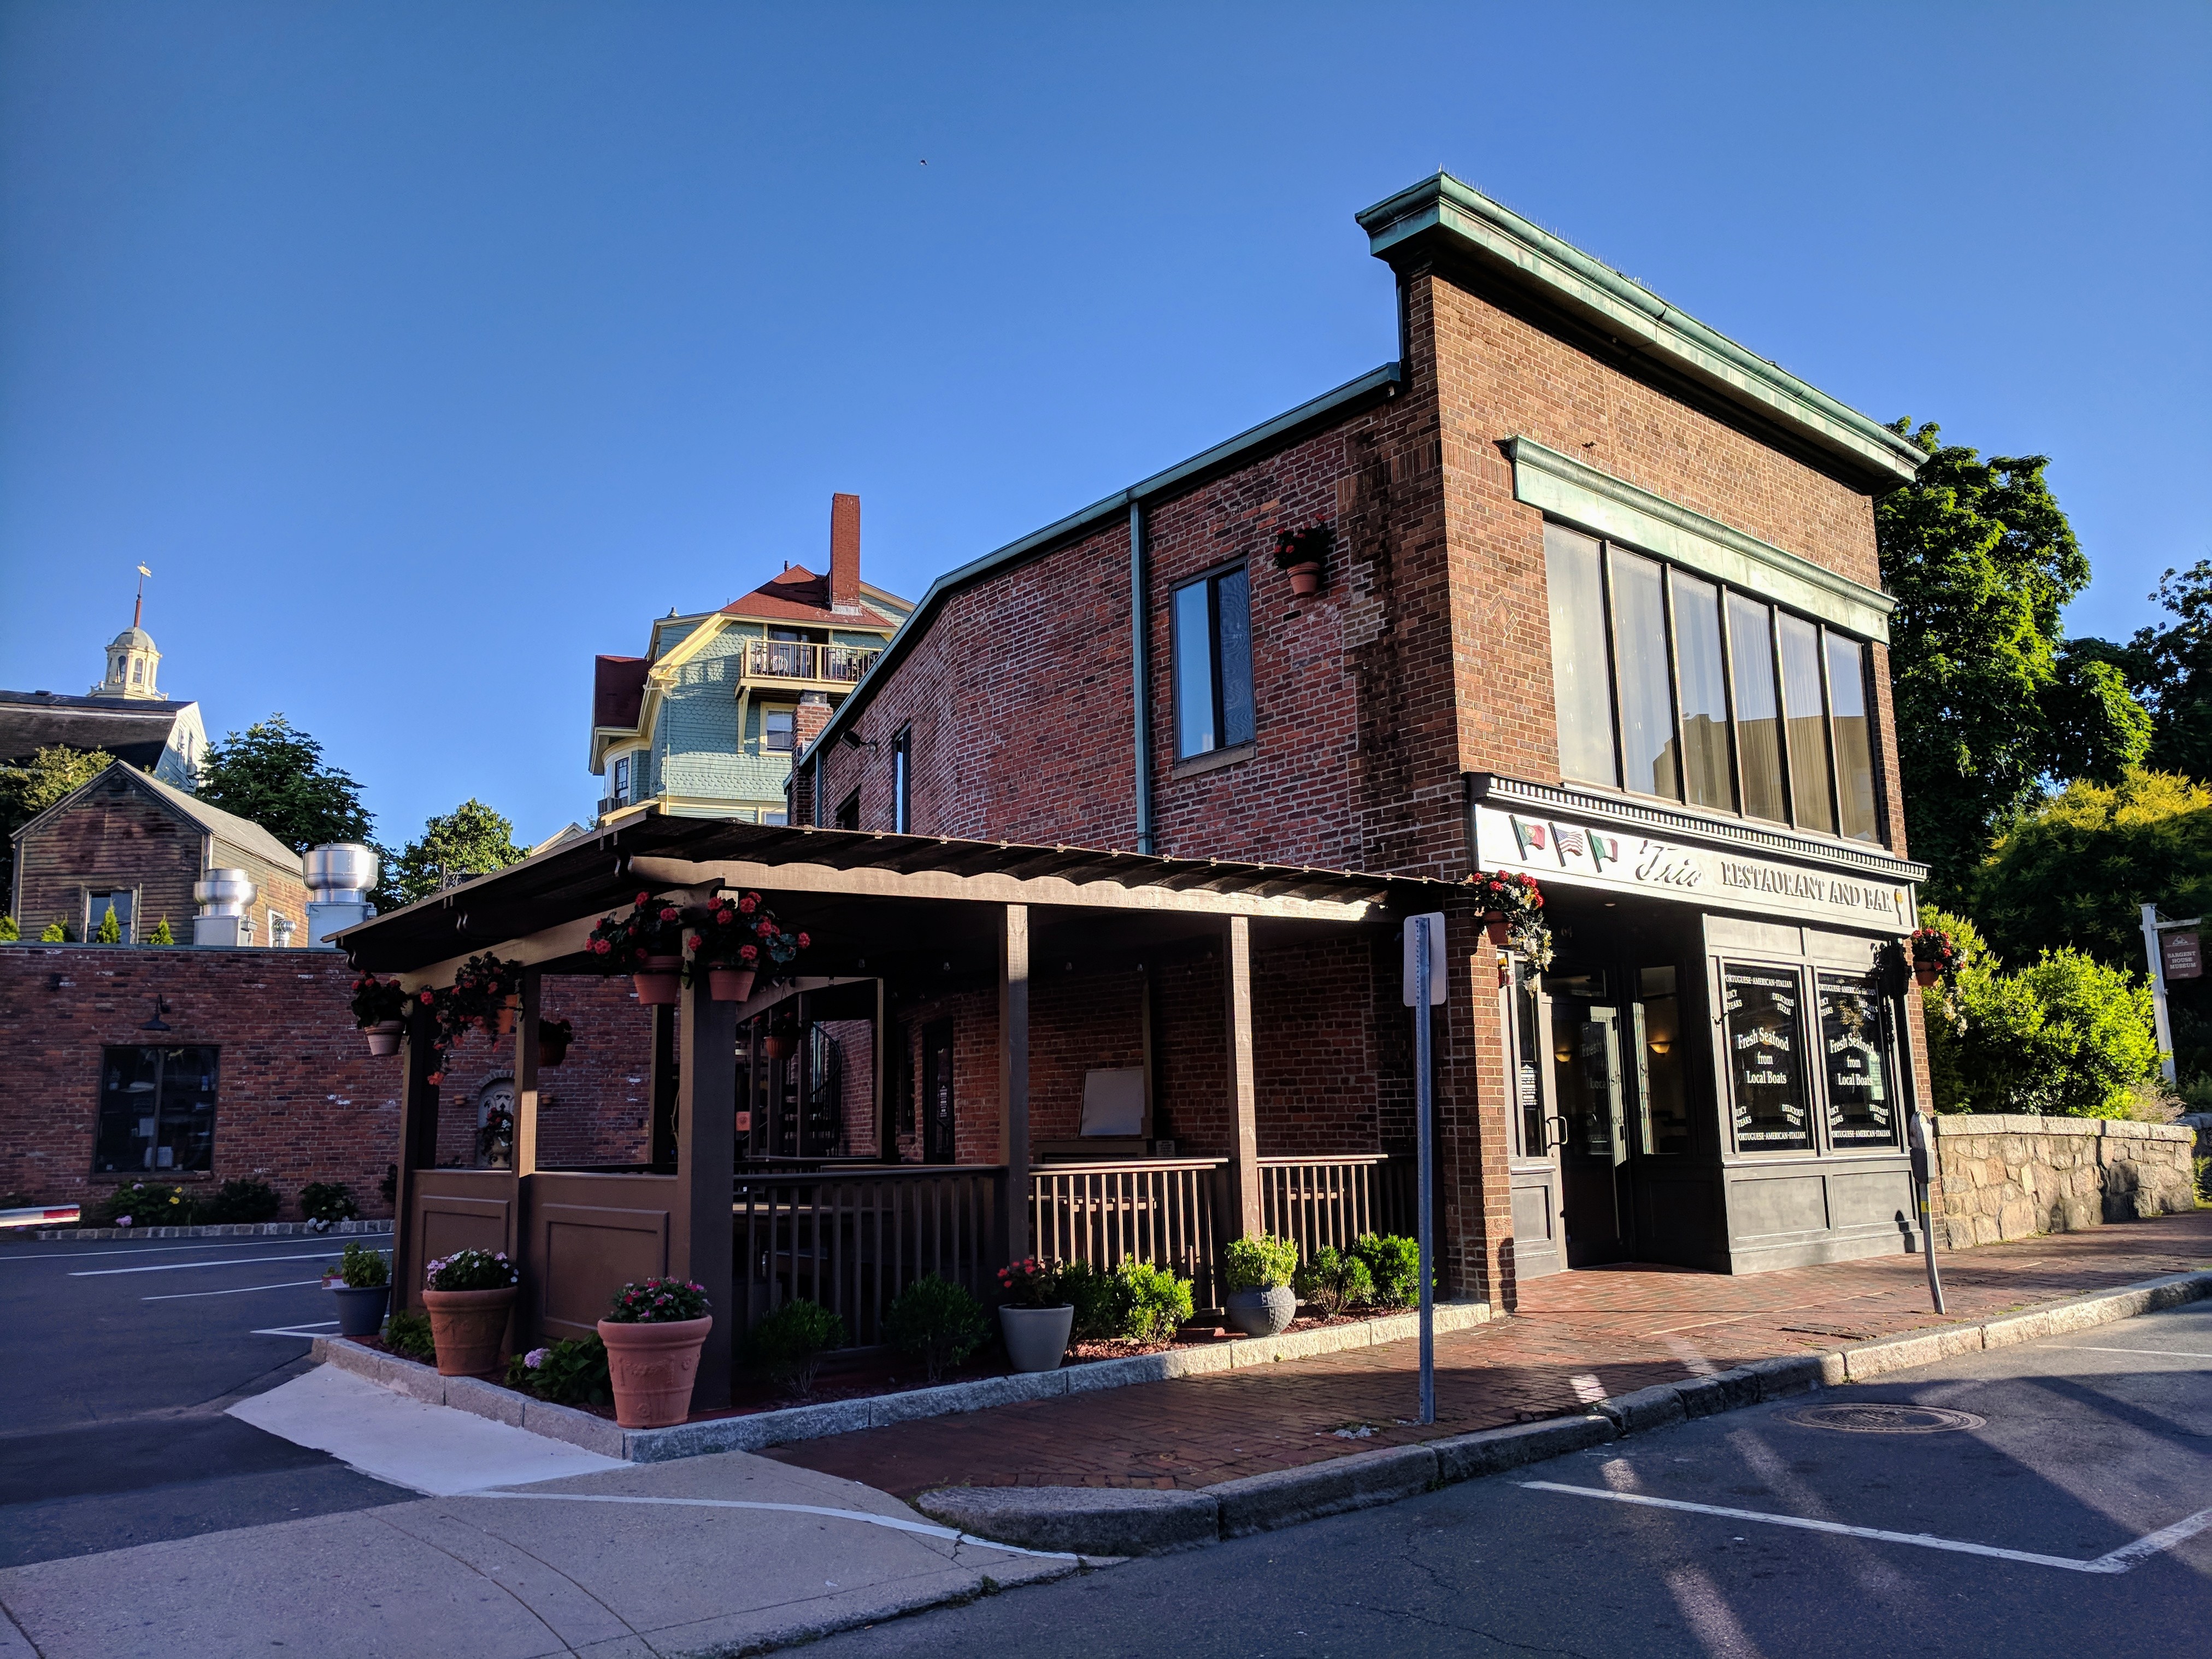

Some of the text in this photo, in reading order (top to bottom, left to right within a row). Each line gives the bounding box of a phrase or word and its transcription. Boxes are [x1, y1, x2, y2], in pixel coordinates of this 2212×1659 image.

[1636, 840, 1893, 912] Trio RESTAURANT AND BAR
[1727, 989, 1738, 999] UICY
[1818, 984, 1840, 992] ORTUGUESE
[1772, 993, 1795, 1007] DELICIOUS
[1820, 997, 1829, 1007] UICY
[1777, 1003, 1791, 1015] PIZZA!
[1821, 1007, 1833, 1016] TEAKS
[1737, 1027, 1790, 1051] Fresh Seafood
[1829, 1032, 1874, 1055] Fresh Seafood
[1757, 1051, 1773, 1064] from
[1846, 1055, 1861, 1068] from
[1746, 1070, 1787, 1084] Local Boats
[1837, 1073, 1873, 1086] Local Boats
[1782, 1104, 1804, 1117] DELICIOUS
[1829, 1105, 1839, 1116] UICY
[1869, 1104, 1889, 1116] DELICIOUS
[1787, 1114, 1801, 1126] PIZZA!
